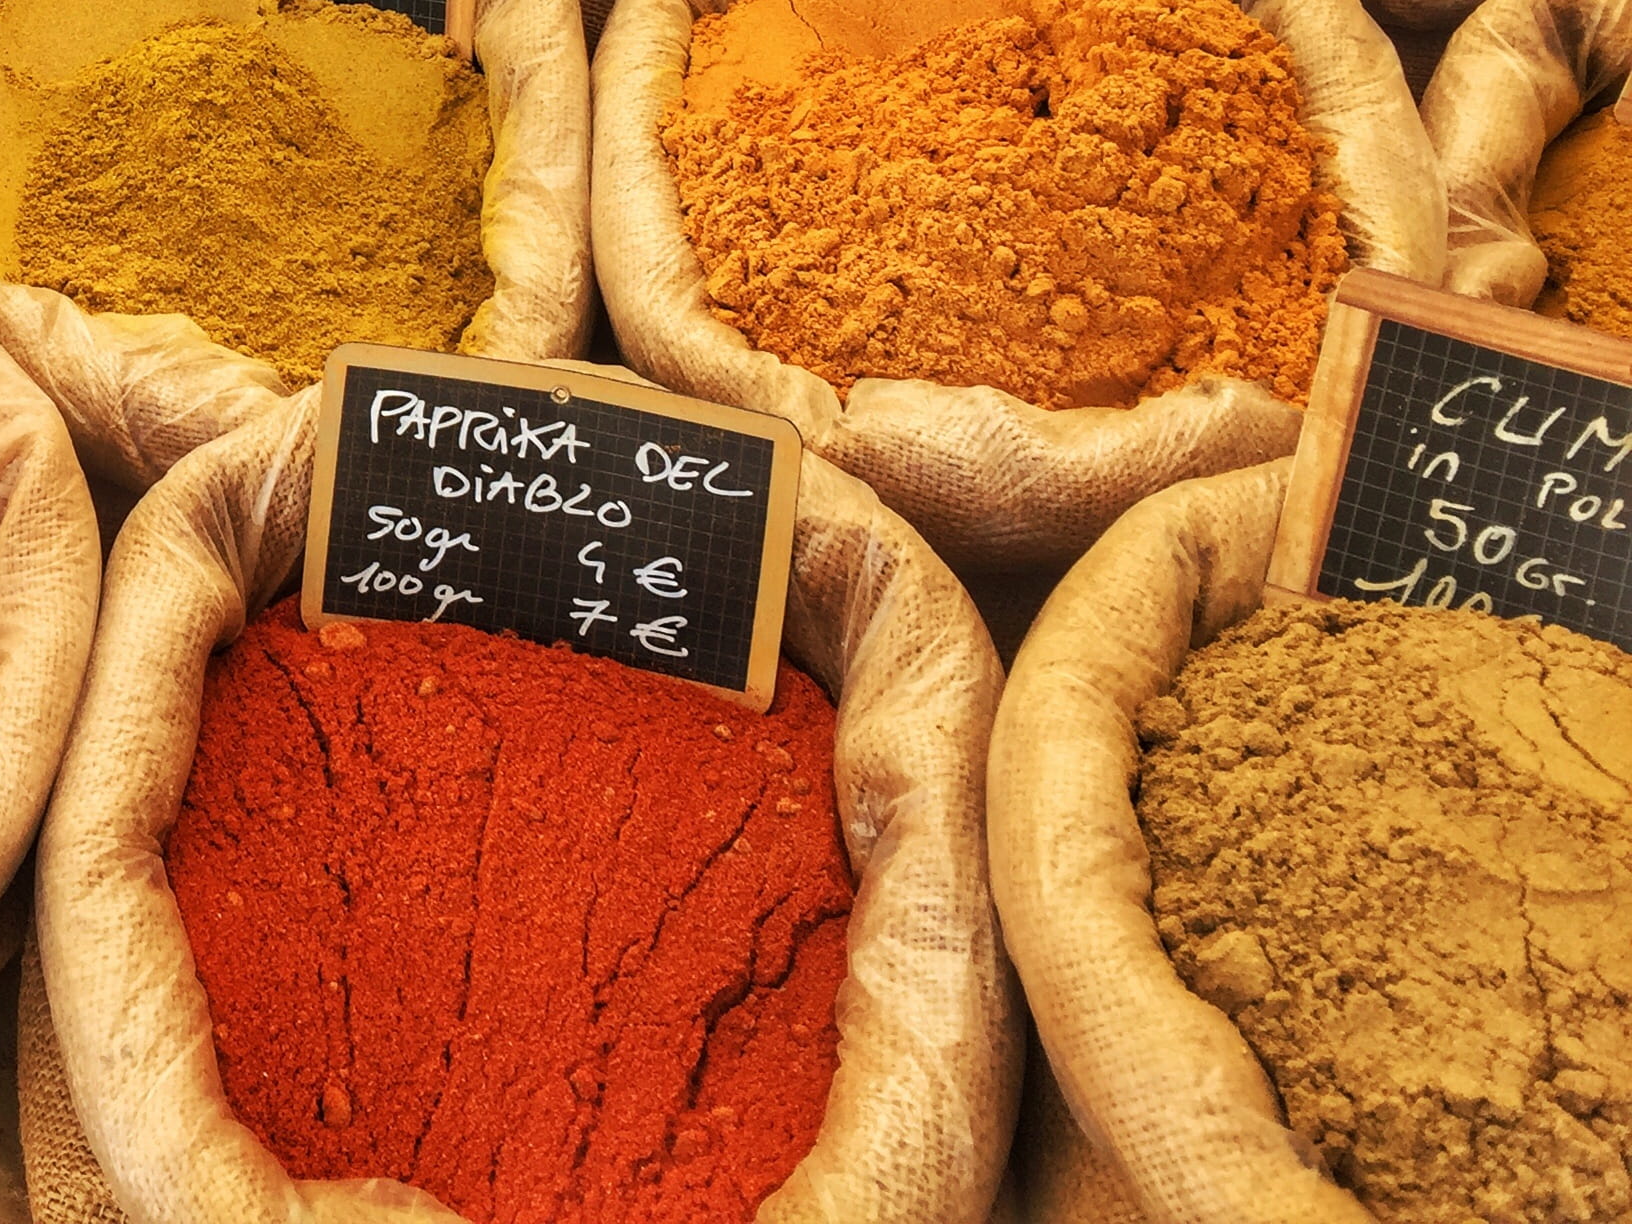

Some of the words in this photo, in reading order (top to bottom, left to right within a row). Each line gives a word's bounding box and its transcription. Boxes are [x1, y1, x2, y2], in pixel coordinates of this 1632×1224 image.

[369, 389, 591, 464] PAPRIKA
[635, 441, 755, 498] DEL
[1407, 427, 1461, 483] in
[340, 561, 424, 594] 100
[568, 597, 619, 637] 7
